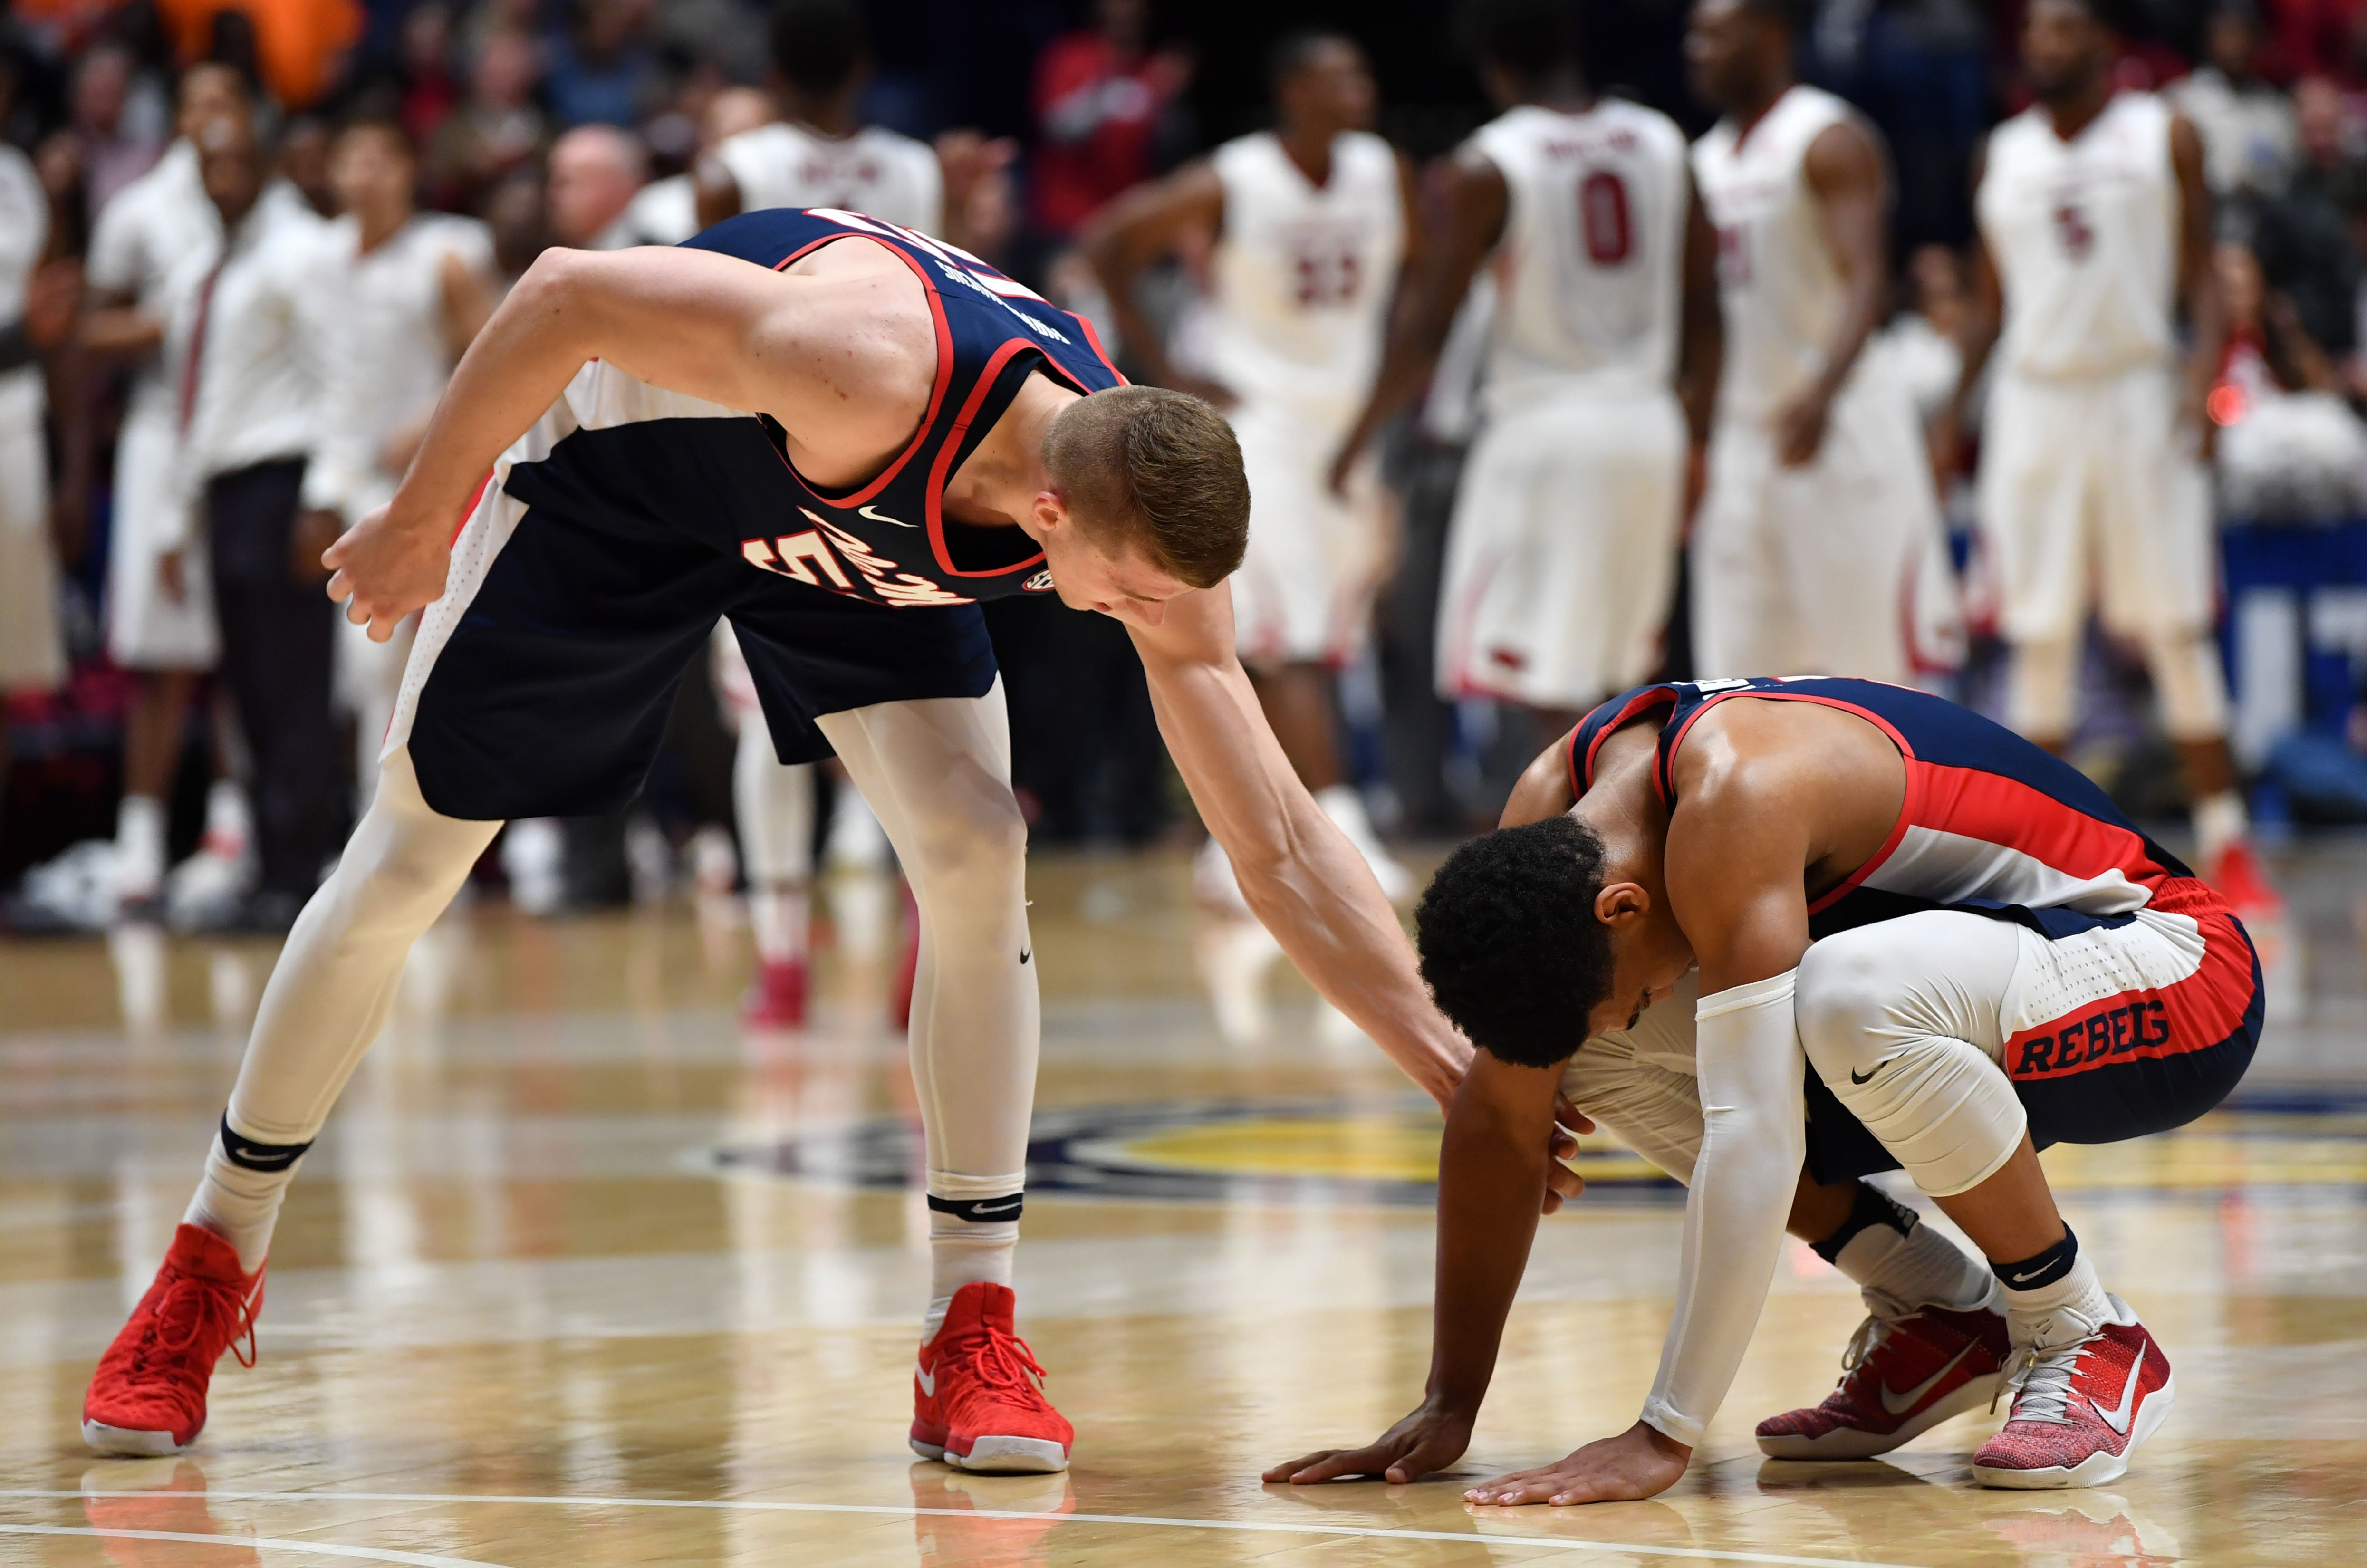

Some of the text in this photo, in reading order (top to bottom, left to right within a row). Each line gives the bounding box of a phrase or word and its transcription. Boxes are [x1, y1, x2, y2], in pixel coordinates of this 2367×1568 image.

[1579, 169, 1633, 267] 0
[741, 528, 856, 590] 5
[2015, 1000, 2169, 1074] REBELS
